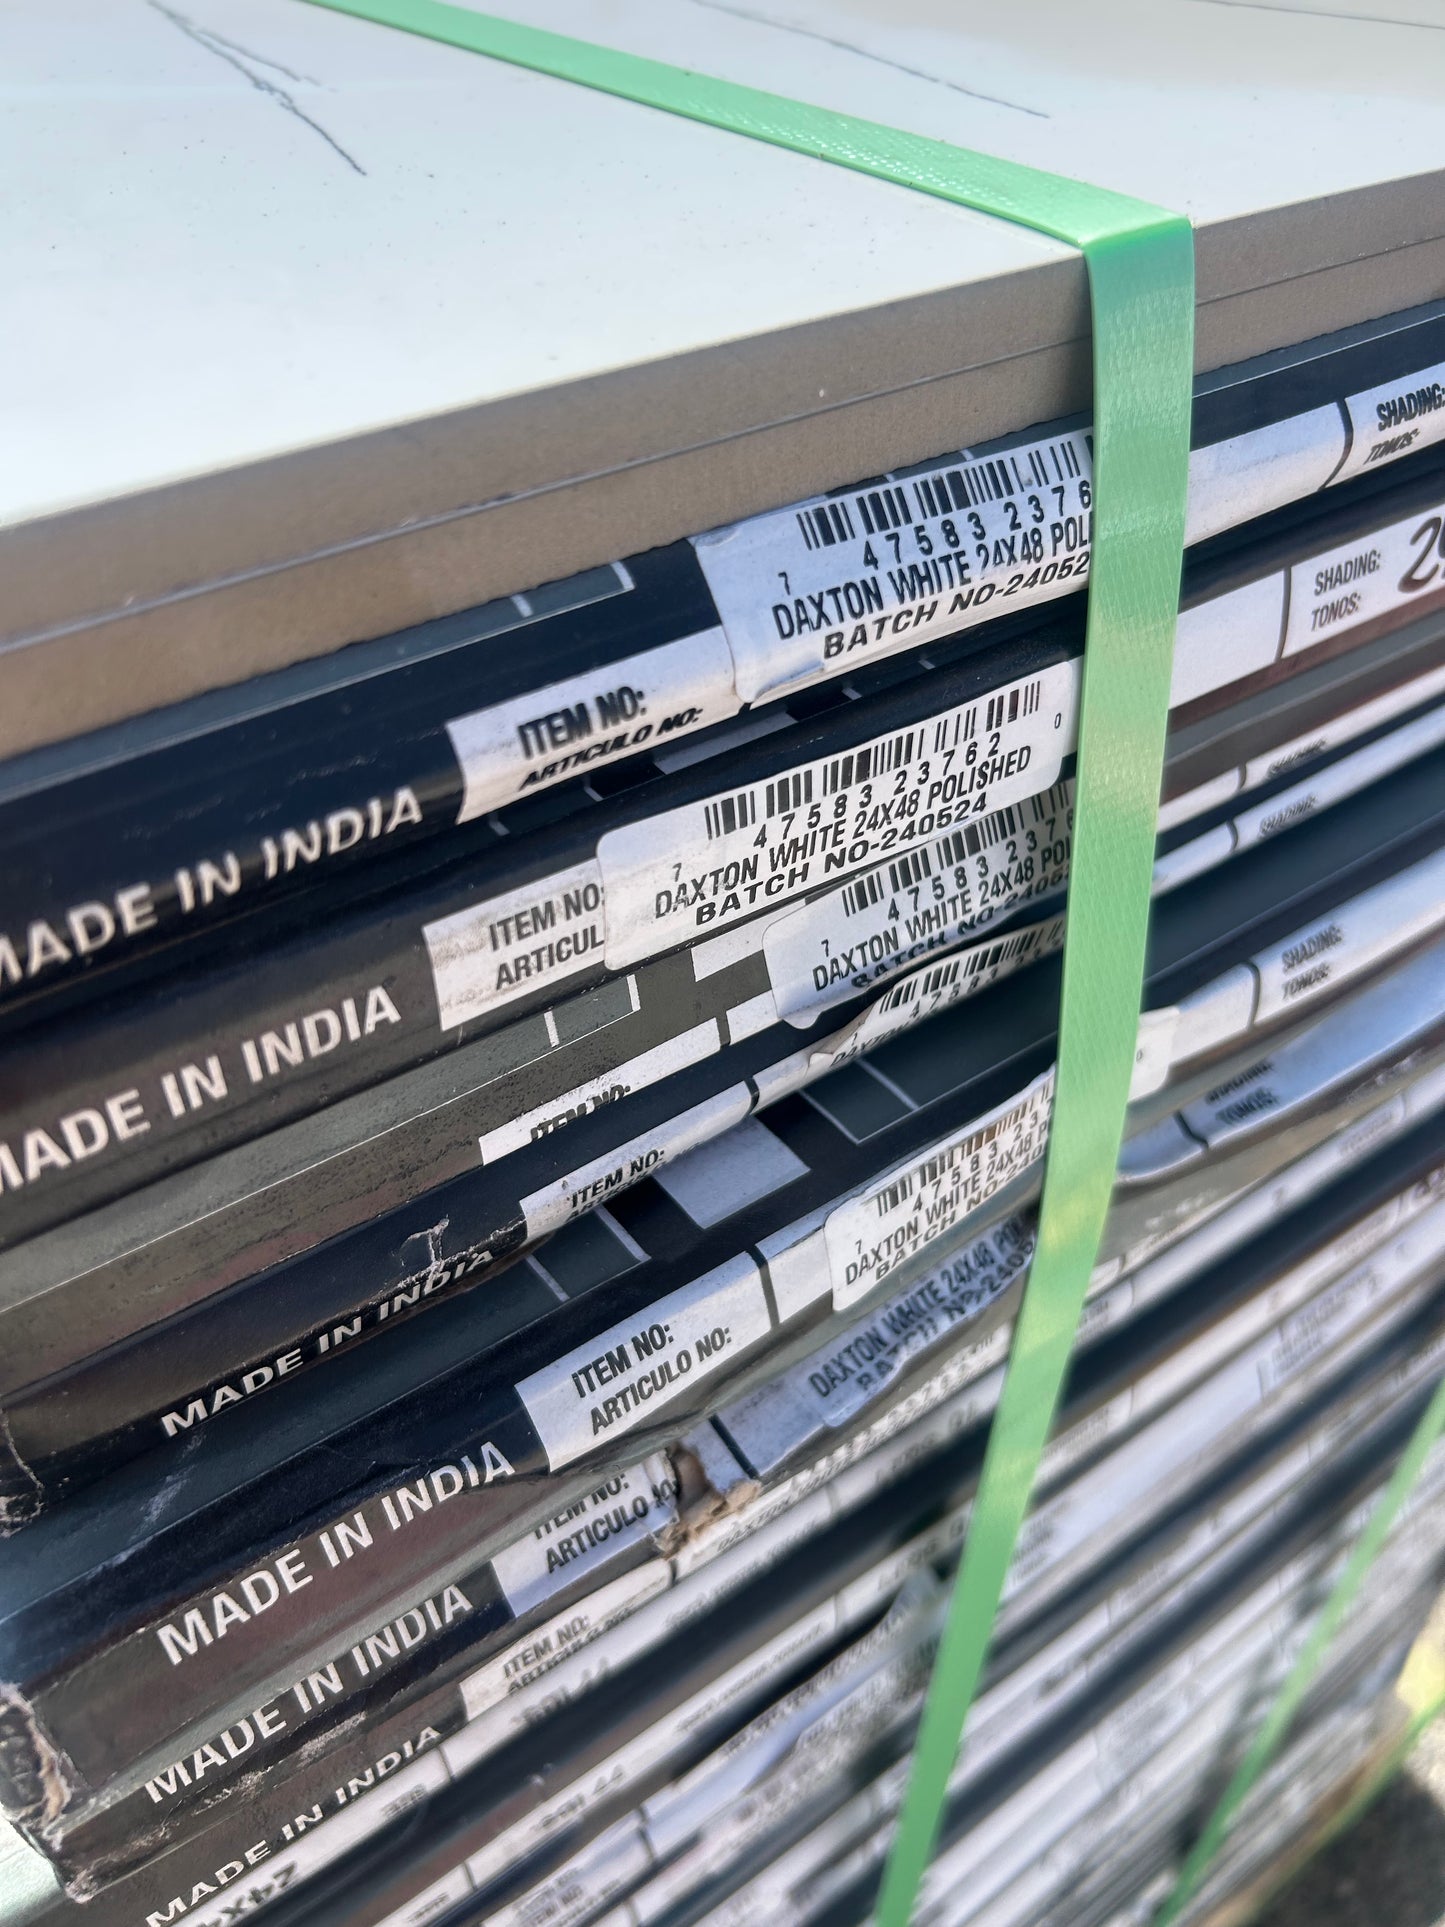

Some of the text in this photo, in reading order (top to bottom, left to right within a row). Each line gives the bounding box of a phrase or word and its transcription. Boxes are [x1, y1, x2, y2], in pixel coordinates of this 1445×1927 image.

[772, 577, 883, 640] DAXTON
[888, 549, 972, 603] WHITE
[976, 528, 1043, 580] 24X48
[1311, 592, 1362, 632] TONOS:
[1314, 549, 1381, 596] SHADING:
[823, 601, 938, 659] BATCH
[518, 685, 648, 759] ITEM NO:
[518, 707, 703, 791] ARTICULO NO:
[175, 850, 241, 914] IN
[260, 785, 422, 879] INDIA
[656, 745, 1032, 919] DAXTON WHITE 24X48 POLISHED
[696, 792, 987, 926] BATCH NO-240524
[489, 899, 556, 951] ITEM
[812, 926, 899, 992] DAXTON
[905, 889, 972, 943] WHITE
[979, 855, 1035, 907] 24X48
[851, 931, 947, 989] BATCH
[161, 1055, 228, 1119] IN
[241, 985, 401, 1083] INDIA
[571, 1167, 624, 1209] ITEM
[845, 1216, 919, 1286] DAXTON
[925, 1171, 981, 1223] WHITE
[986, 1130, 1033, 1183] 24X48
[875, 1210, 956, 1281] BATCH
[160, 1250, 495, 1437] MADE IN INDIA
[571, 1323, 674, 1399] ITEM NO:
[590, 1326, 732, 1436] ARTICULO NO:
[808, 1326, 888, 1398] DAXTON
[881, 1279, 946, 1335] WHITE
[156, 1441, 515, 1666] MADE IN INDIA
[546, 1495, 649, 1574] ARTICULO
[143, 1583, 473, 1804] MADE IN INDIA
[503, 1615, 591, 1679] ITEM NO:
[144, 1839, 272, 1927] MADE
[281, 1803, 323, 1841] IN
[334, 1726, 442, 1804] INDIA
